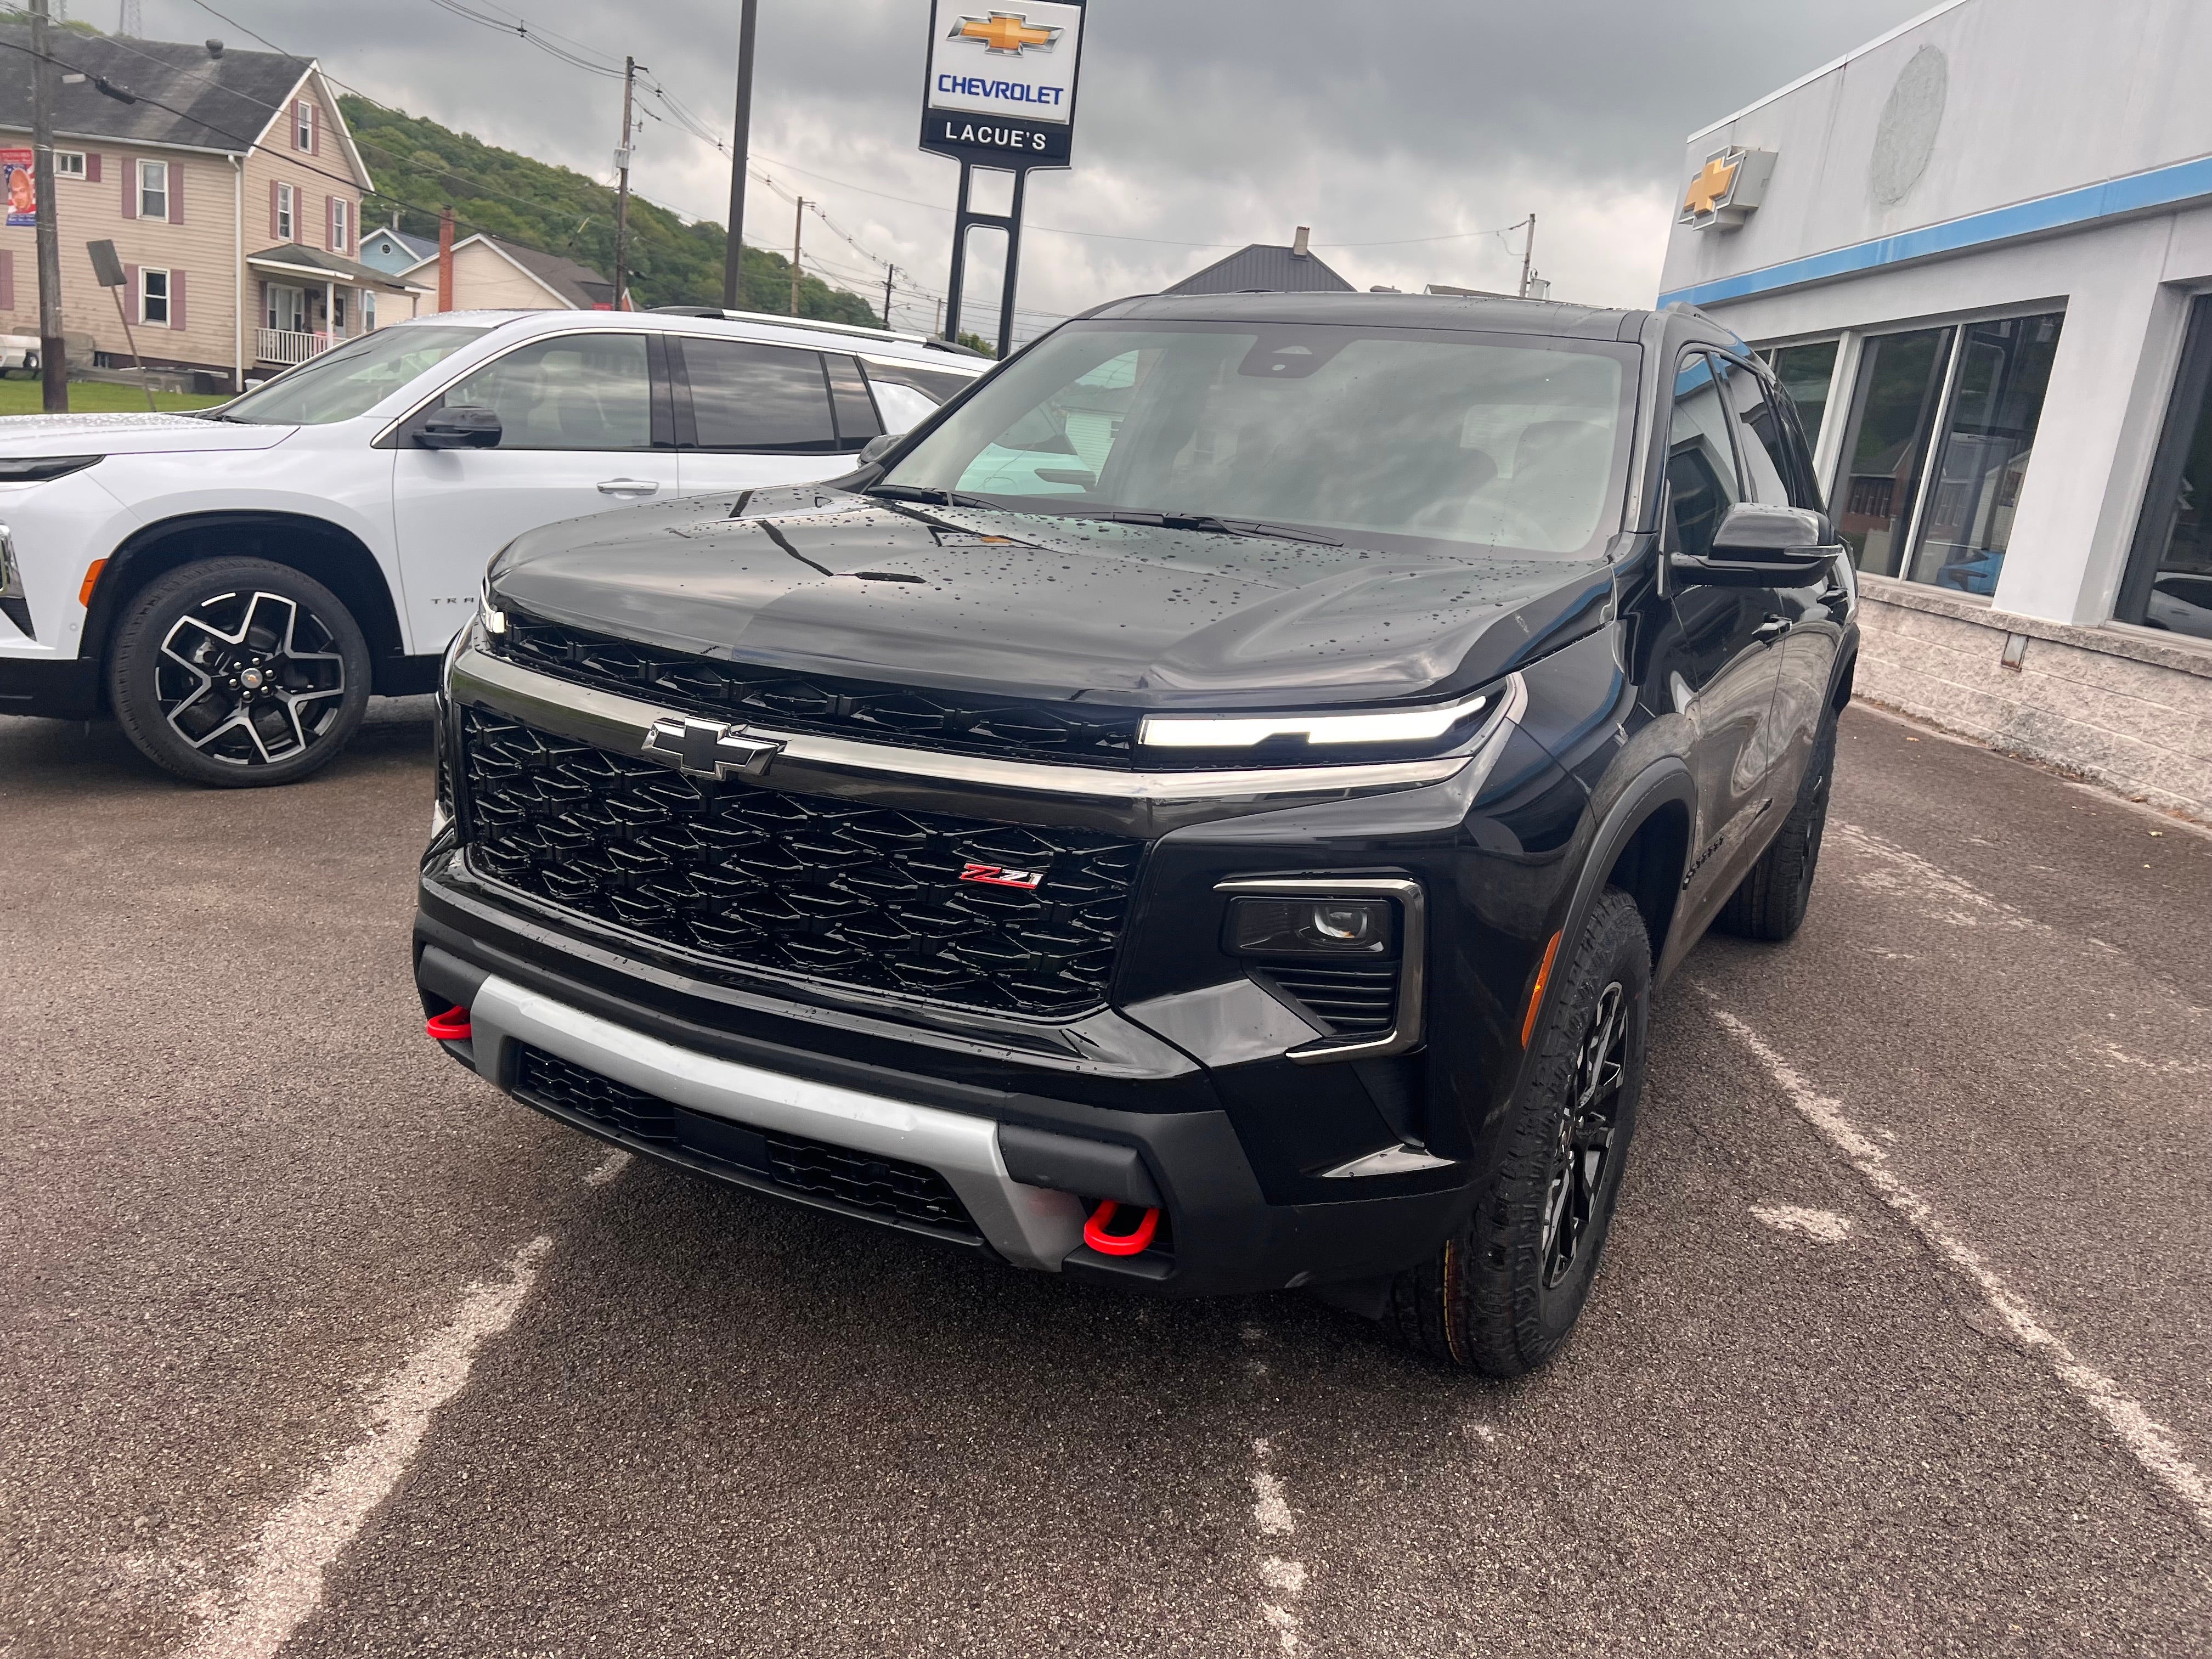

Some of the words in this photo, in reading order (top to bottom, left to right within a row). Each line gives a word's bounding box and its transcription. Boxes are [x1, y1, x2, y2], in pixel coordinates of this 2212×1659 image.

[938, 74, 1064, 105] CHEVROLET
[945, 122, 1046, 150] LACUE'S
[959, 863, 1043, 889] Z71
